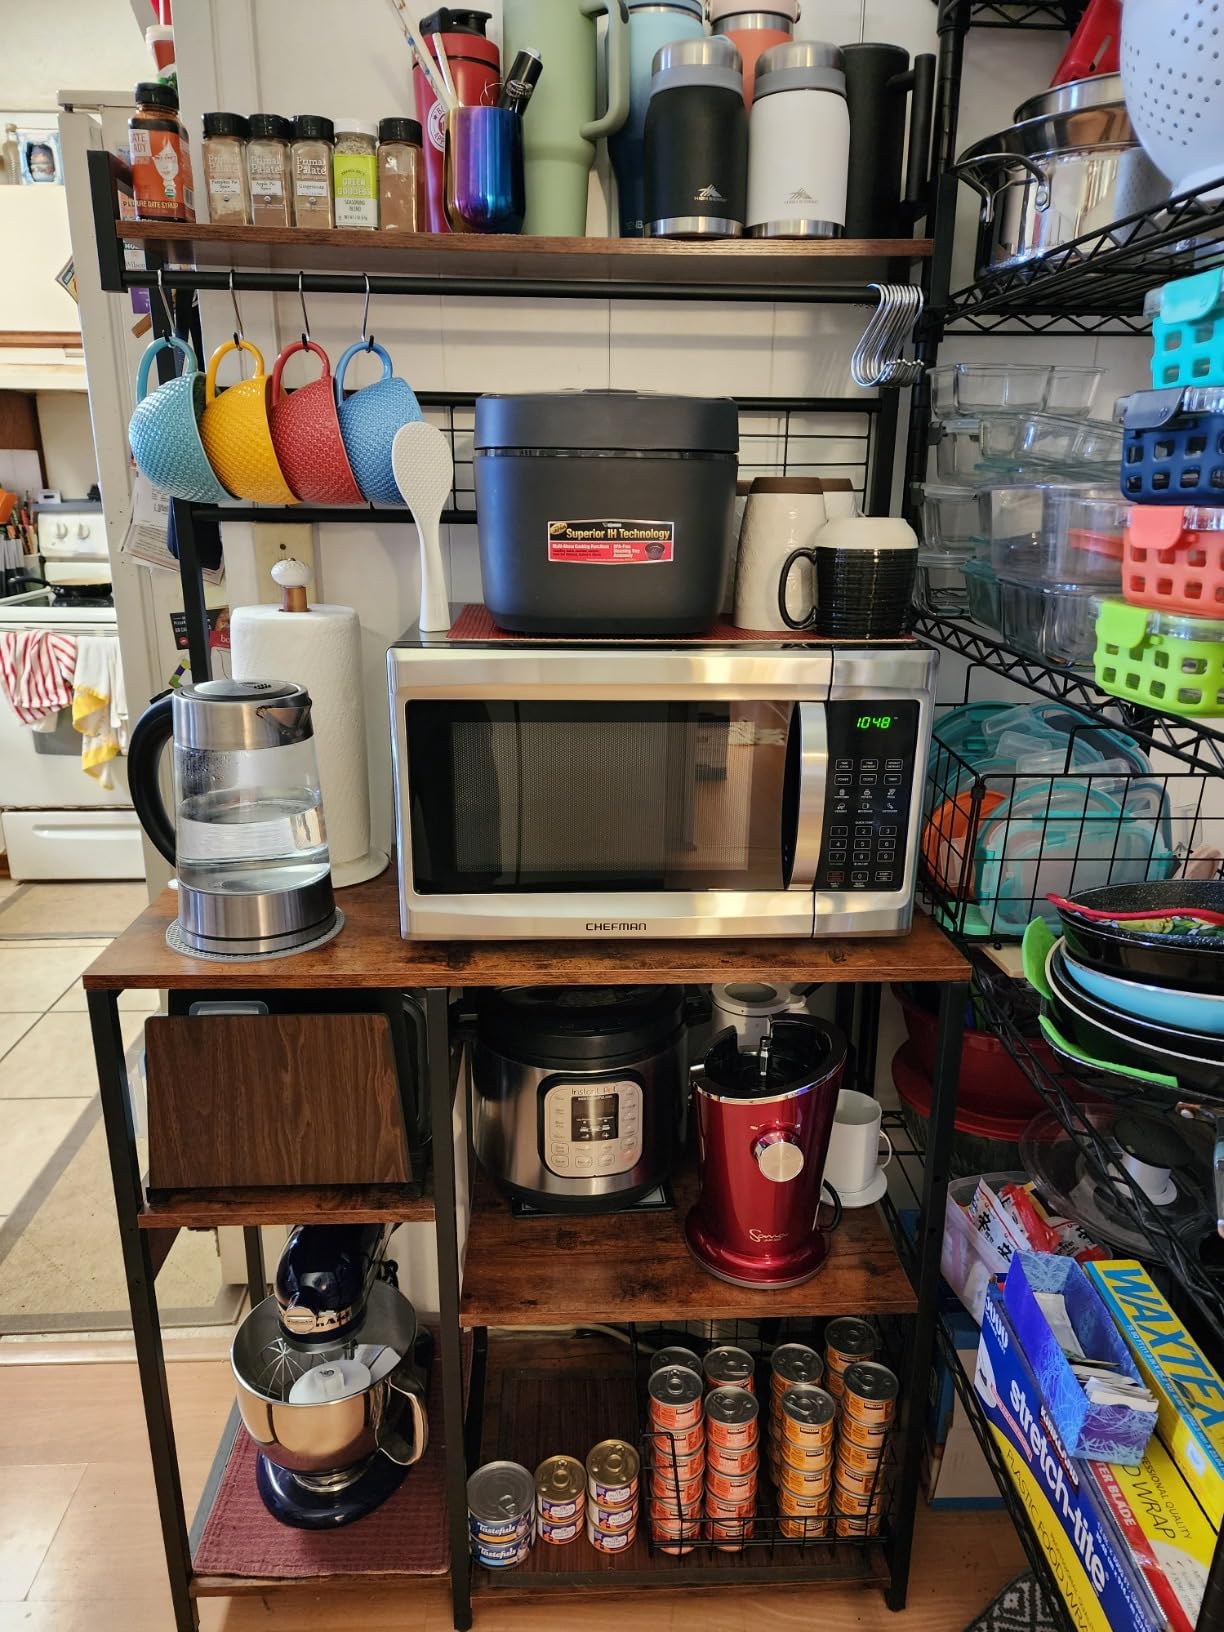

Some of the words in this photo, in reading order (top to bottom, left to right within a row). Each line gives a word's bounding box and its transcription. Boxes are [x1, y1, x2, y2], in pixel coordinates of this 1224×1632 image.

[297, 157, 326, 166] Primal
[297, 165, 327, 174] Palate
[566, 528, 606, 540] Superior
[608, 528, 618, 538] IH
[619, 528, 670, 540] Technology
[585, 922, 647, 931] CHEFMAN
[1010, 1379, 1106, 1593] stretch-tite
[1107, 1485, 1137, 1526] BLADE
[1132, 1481, 1176, 1539] WRAP
[1006, 1448, 1040, 1518] PLASTIC
[1037, 1520, 1064, 1582] FOOD
[1164, 1501, 1192, 1540] QUALITY
[477, 1522, 516, 1536] Tastefuls
[479, 1545, 517, 1560] Tastefuls
